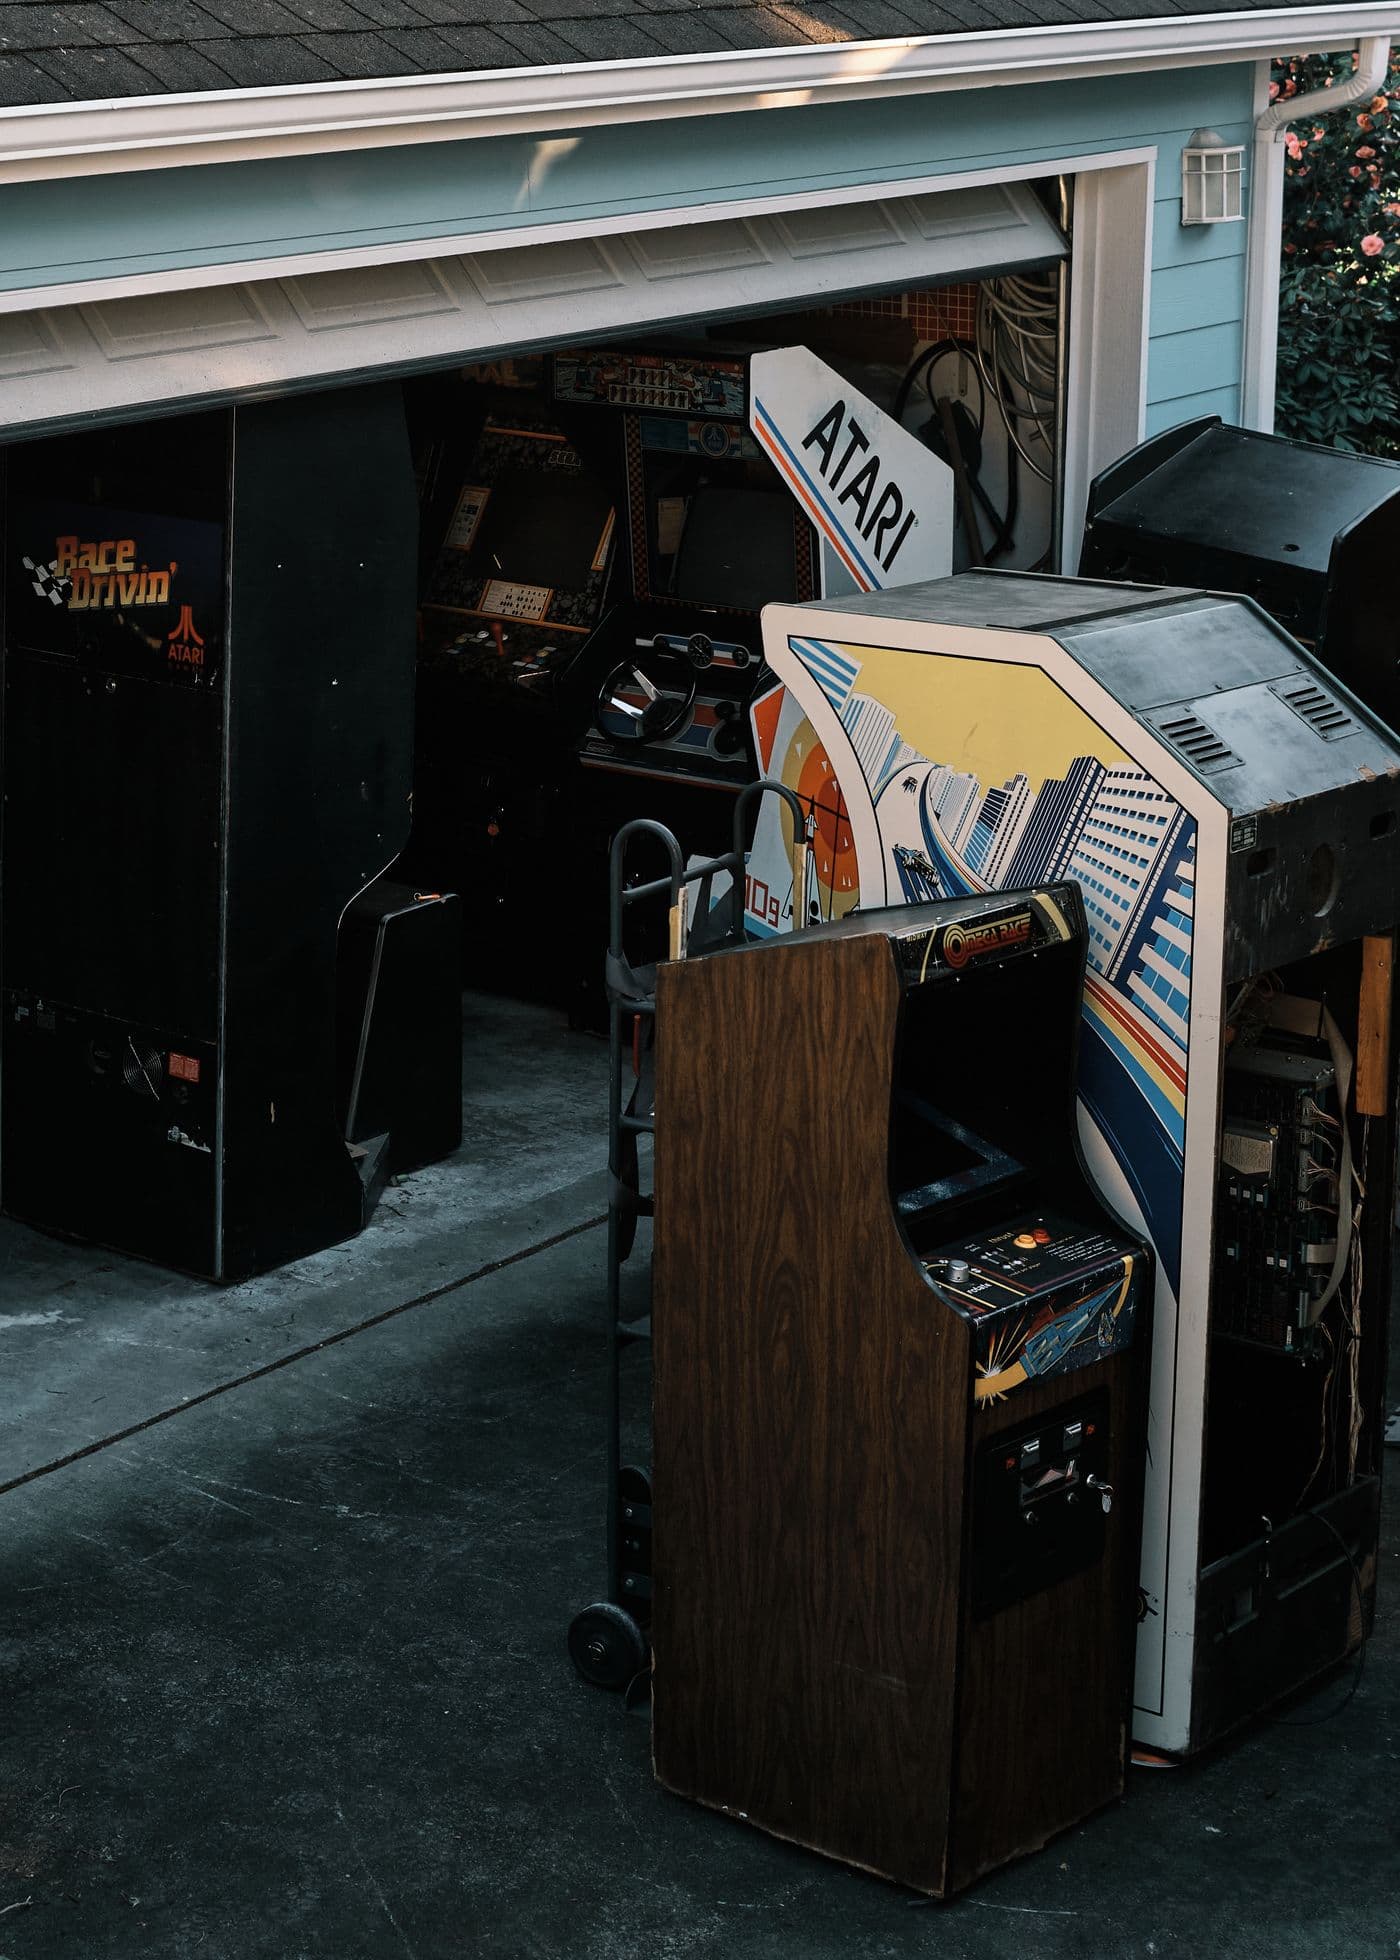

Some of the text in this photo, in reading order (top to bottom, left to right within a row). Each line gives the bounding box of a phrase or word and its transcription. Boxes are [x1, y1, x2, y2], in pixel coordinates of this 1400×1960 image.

[801, 399, 916, 573] ATARI
[55, 535, 137, 577] Race
[167, 641, 205, 665] ATARI
[999, 917, 1032, 939] RACE
